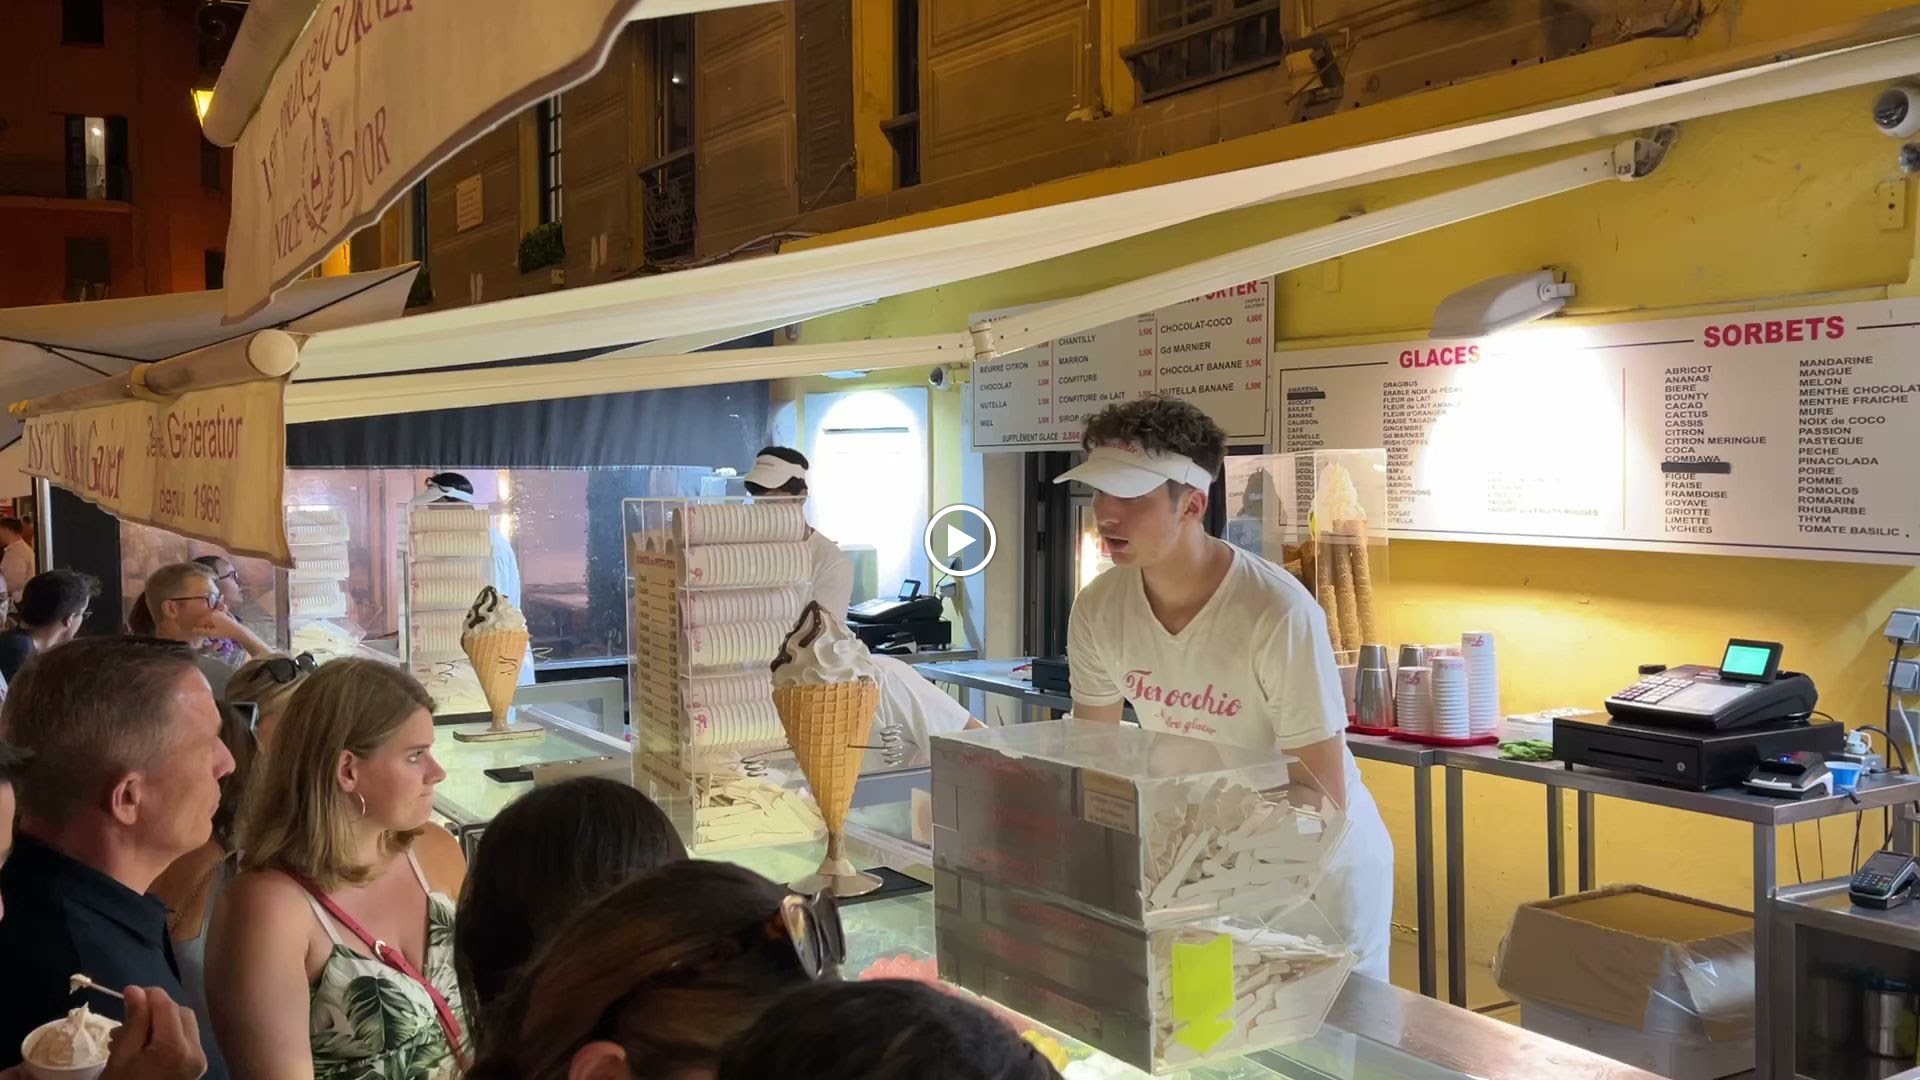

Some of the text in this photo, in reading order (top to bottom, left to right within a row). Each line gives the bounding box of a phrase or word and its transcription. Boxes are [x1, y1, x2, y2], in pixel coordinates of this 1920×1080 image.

[1160, 317, 1233, 334] CHOCOLAT-COCO
[1704, 316, 1845, 348] SORBETS
[1058, 335, 1096, 346] CHANTILLY
[1160, 346, 1172, 355] Gd
[1173, 341, 1211, 354] MARNIER
[1058, 356, 1089, 365] MARRON
[1399, 345, 1481, 369] GLACES
[1799, 356, 1873, 367] MANDARINE
[1006, 362, 1029, 371] CITRON
[1160, 363, 1204, 376] CHOCOLAT
[1206, 359, 1243, 372] BANANE
[1665, 366, 1713, 375] ABRICOT
[1799, 367, 1853, 377] MANGUE
[1059, 374, 1098, 385] CONFITURE
[1665, 375, 1710, 384] ANANAS
[1799, 378, 1842, 387] MELON
[980, 381, 1013, 391] CHOCOLAT
[1198, 382, 1235, 394] BANANE
[1665, 384, 1697, 393] BIERE
[1383, 389, 1410, 397] ERABLE
[1411, 387, 1428, 395] NOIX
[1799, 387, 1849, 396] MENTHE
[1059, 395, 1098, 404] CONFITURE
[1099, 393, 1108, 401] de
[1109, 391, 1126, 401] LAIT
[1665, 393, 1709, 401] BOUNTY
[1799, 395, 1909, 406] MENTHE FRAICHE
[980, 400, 1008, 409] NUTELLA
[1665, 402, 1703, 410] CACAO
[1665, 411, 1709, 419] CACTUS
[1799, 407, 1834, 416] MURE
[1058, 414, 1080, 423] SIROP
[1799, 416, 1886, 425] NOIX de COCO
[1665, 420, 1704, 428] CASSIS
[1665, 429, 1705, 437] CITRON
[1799, 427, 1852, 436] PASSION
[1665, 436, 1767, 445] CITRON MERINGUE
[1799, 436, 1864, 446] PASTEQUE
[1665, 446, 1696, 454] COCA
[1799, 447, 1839, 455] PECHE
[1665, 455, 1721, 463] COMBAWA
[1798, 457, 1879, 466] PINACOLADA
[1798, 466, 1835, 475] POIRE
[1665, 481, 1703, 489] FRAISE
[1798, 476, 1843, 485] POMME
[1665, 490, 1727, 499] FRAMBOISE
[1798, 486, 1859, 495] POMOLOS
[193, 484, 220, 524] 1966
[1665, 499, 1708, 507] GOYAVE
[1798, 496, 1855, 505] ROMARIN
[1665, 508, 1711, 517] GRIOTTE
[1798, 505, 1866, 516] RHUBARBE
[1665, 516, 1709, 525] LIMETTE
[1798, 515, 1832, 523] THYM
[1665, 525, 1713, 534] LYCHEES
[1798, 524, 1900, 536] TOMATE BASILIC
